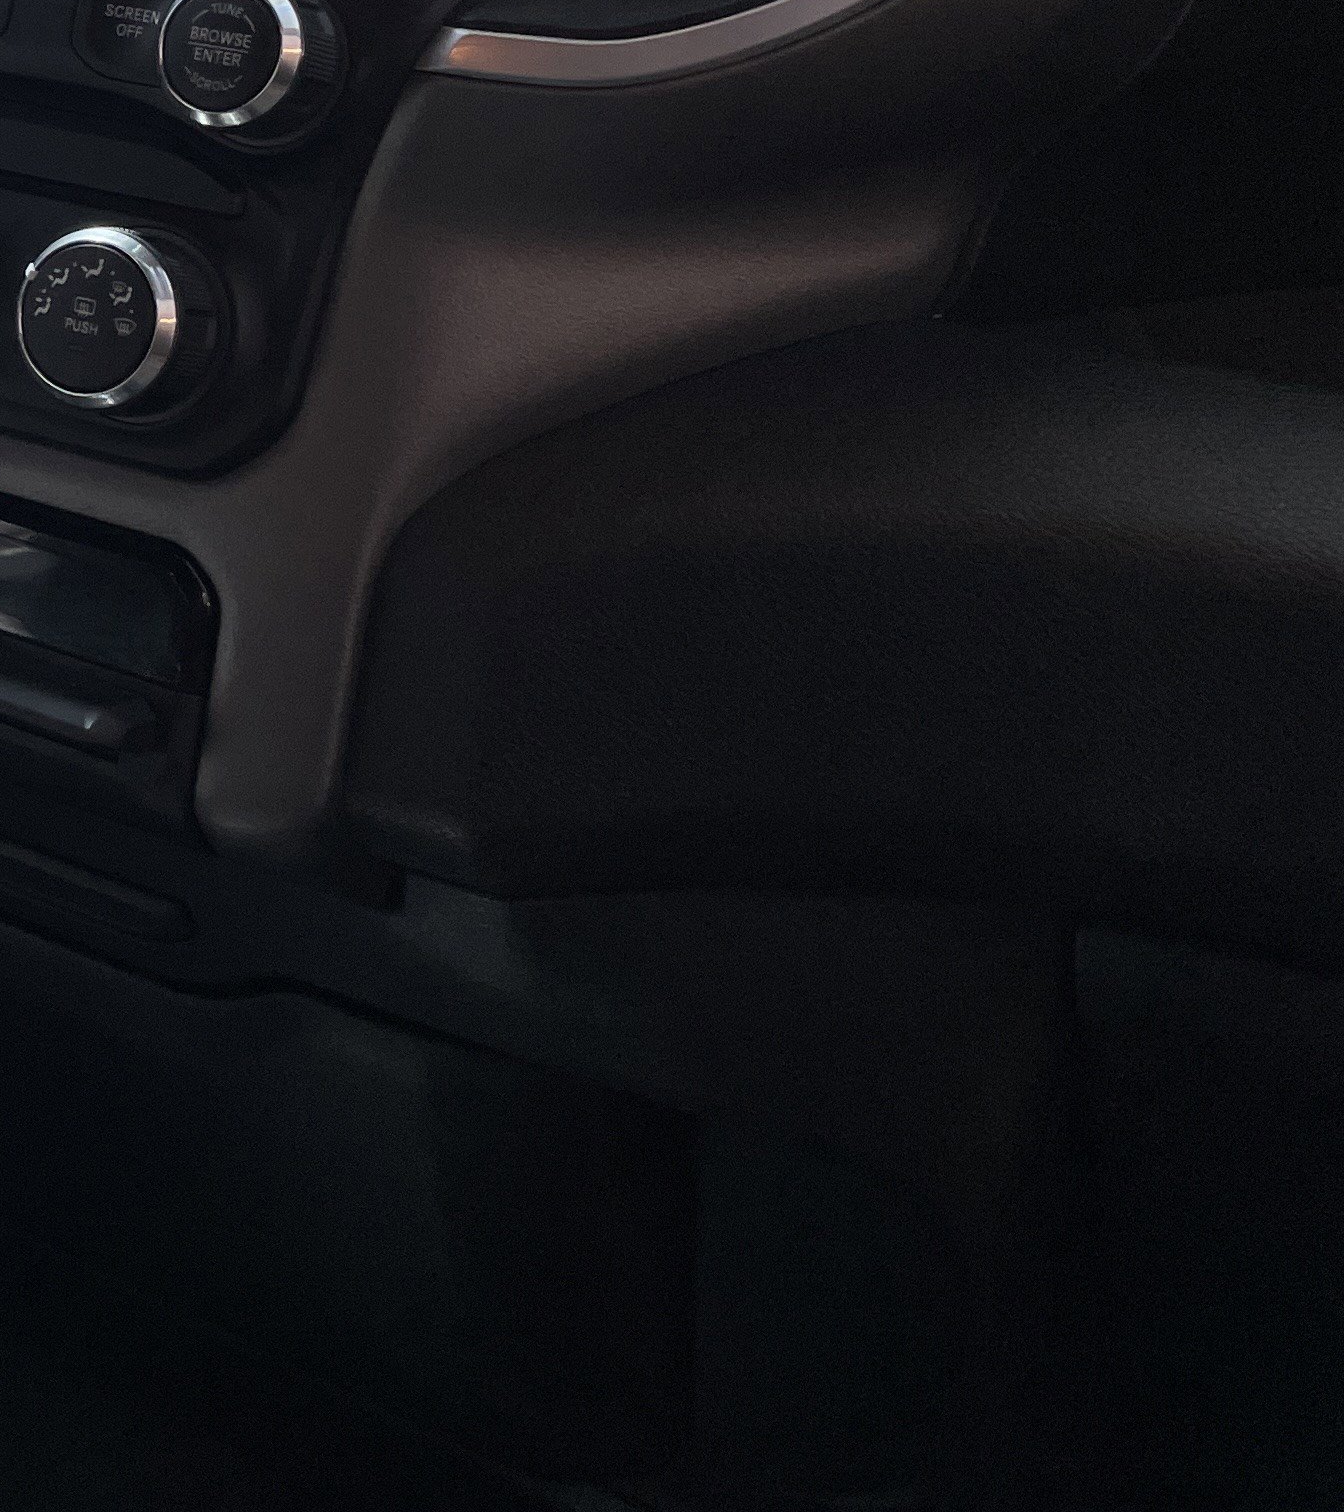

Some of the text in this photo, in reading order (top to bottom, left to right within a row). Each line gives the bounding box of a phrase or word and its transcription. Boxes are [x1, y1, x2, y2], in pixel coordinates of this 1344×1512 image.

[104, 4, 160, 25] SCREEN
[211, 2, 244, 19] TUNE
[116, 23, 144, 38] OFF
[189, 25, 252, 49] BROWSE
[193, 46, 242, 68] ENTER
[64, 317, 99, 336] PUSH
